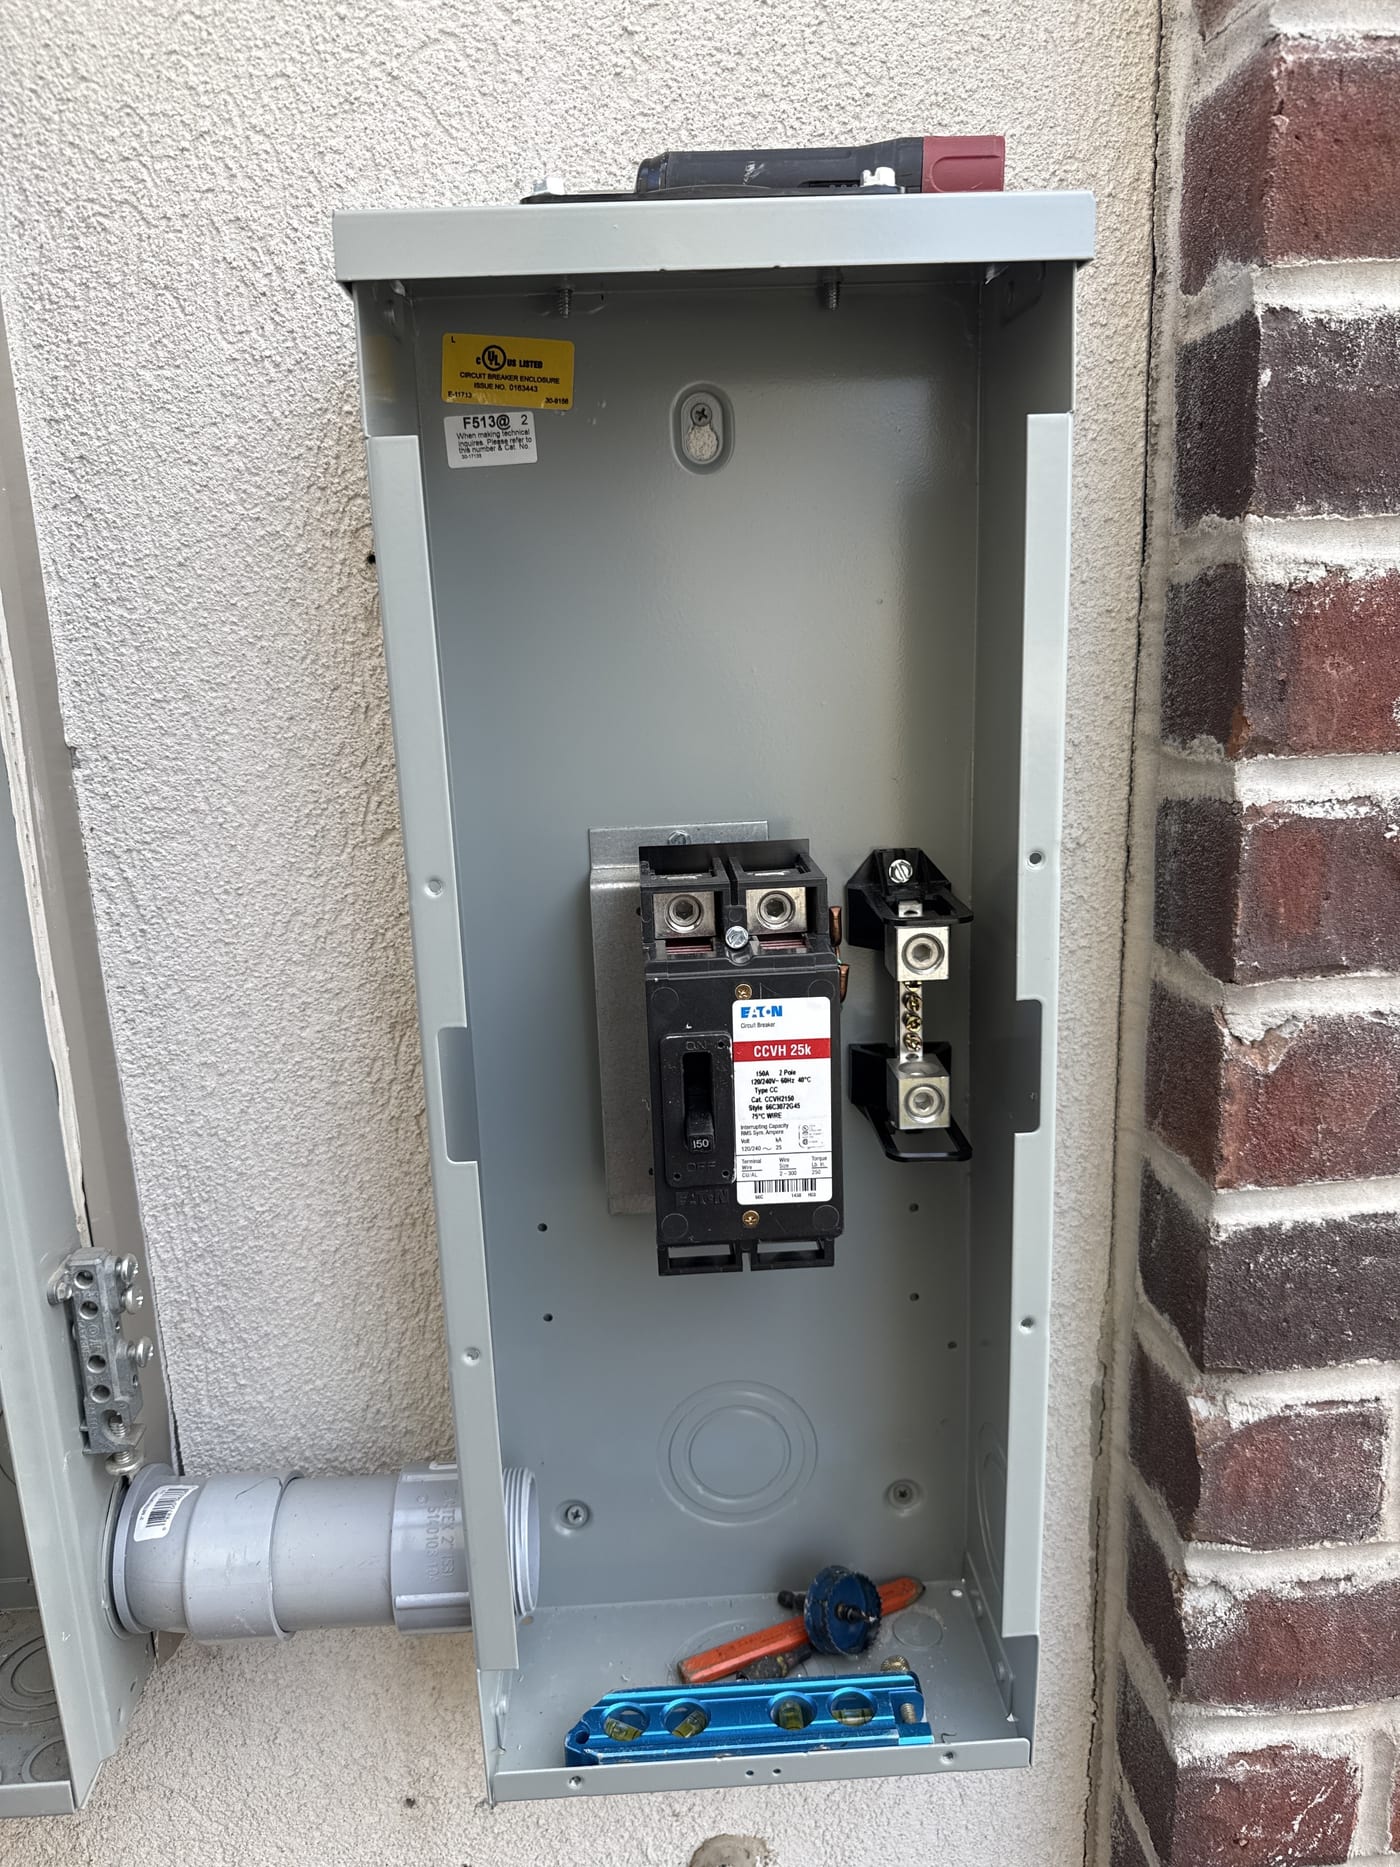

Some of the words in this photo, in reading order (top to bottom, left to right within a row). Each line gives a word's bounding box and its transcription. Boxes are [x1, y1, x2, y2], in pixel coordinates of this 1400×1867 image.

[507, 359, 516, 367] US
[519, 360, 543, 369] LISTED
[460, 372, 486, 380] CIRCUIT
[487, 373, 519, 382] BREAKER
[520, 375, 560, 384] ENCLOSURE
[474, 382, 493, 390] ISSUE
[463, 414, 511, 430] F513@
[521, 414, 528, 425] 2
[456, 431, 477, 440] When
[478, 430, 500, 440] making
[502, 428, 530, 438] technical
[487, 437, 508, 446] Please
[510, 436, 524, 444] refer
[458, 445, 471, 454] this
[472, 444, 496, 453] number
[754, 1045, 786, 1057] CCVH
[790, 1044, 811, 1056] 25k
[756, 1069, 769, 1077] 150A
[755, 1087, 768, 1095] Type
[765, 1095, 794, 1103] CCVH2150
[749, 1104, 763, 1112] Style
[692, 1138, 710, 1149] 150
